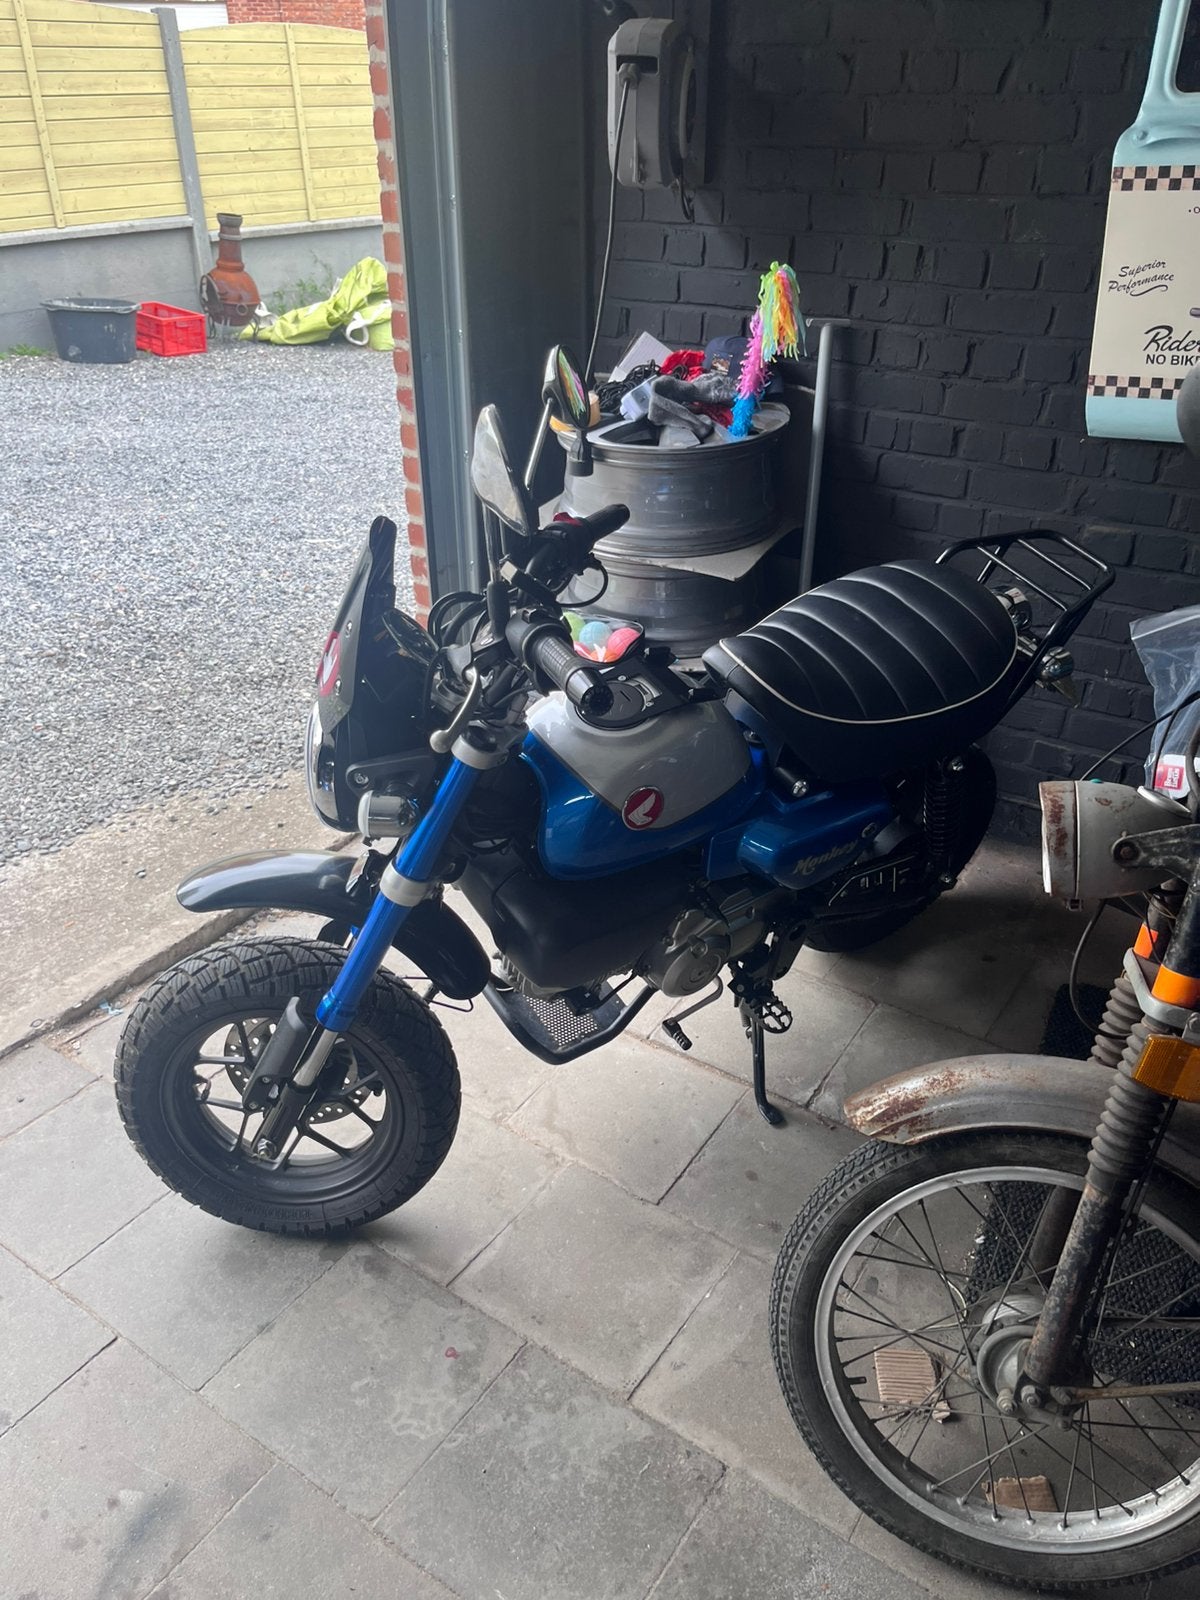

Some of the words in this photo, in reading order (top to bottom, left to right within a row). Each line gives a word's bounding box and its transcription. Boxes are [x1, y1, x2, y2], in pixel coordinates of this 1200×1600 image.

[1118, 260, 1167, 278] Superior
[1108, 273, 1175, 293] Performance
[1146, 353, 1166, 365] NO
[792, 838, 859, 876] Monkey
